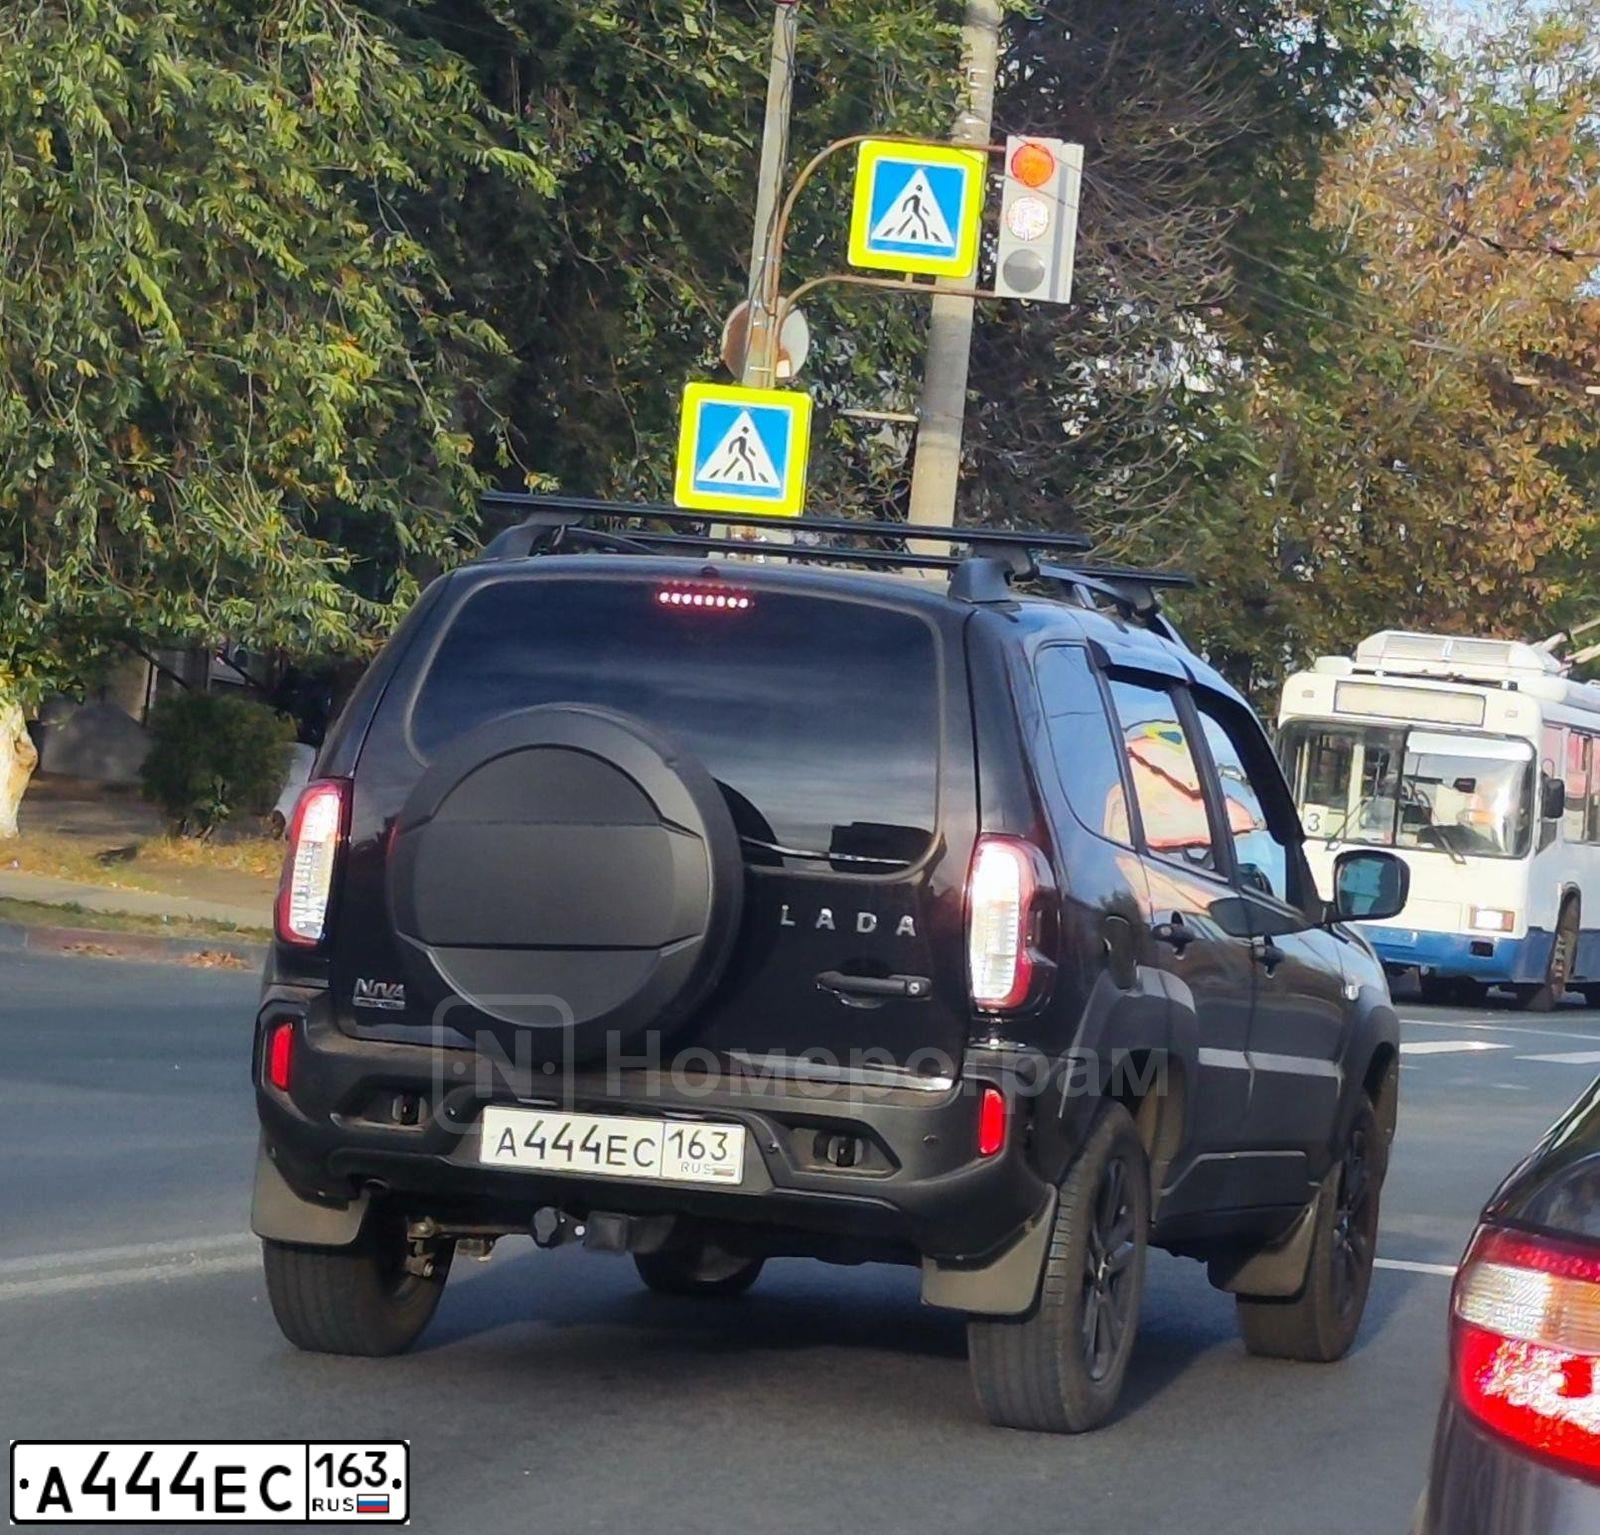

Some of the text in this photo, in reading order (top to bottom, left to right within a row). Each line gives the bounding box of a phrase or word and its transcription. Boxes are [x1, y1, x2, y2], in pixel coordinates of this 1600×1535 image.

[1307, 812, 1321, 832] 3
[780, 904, 917, 937] LADA
[668, 1128, 729, 1161] 163
[680, 1161, 713, 1176] RUS
